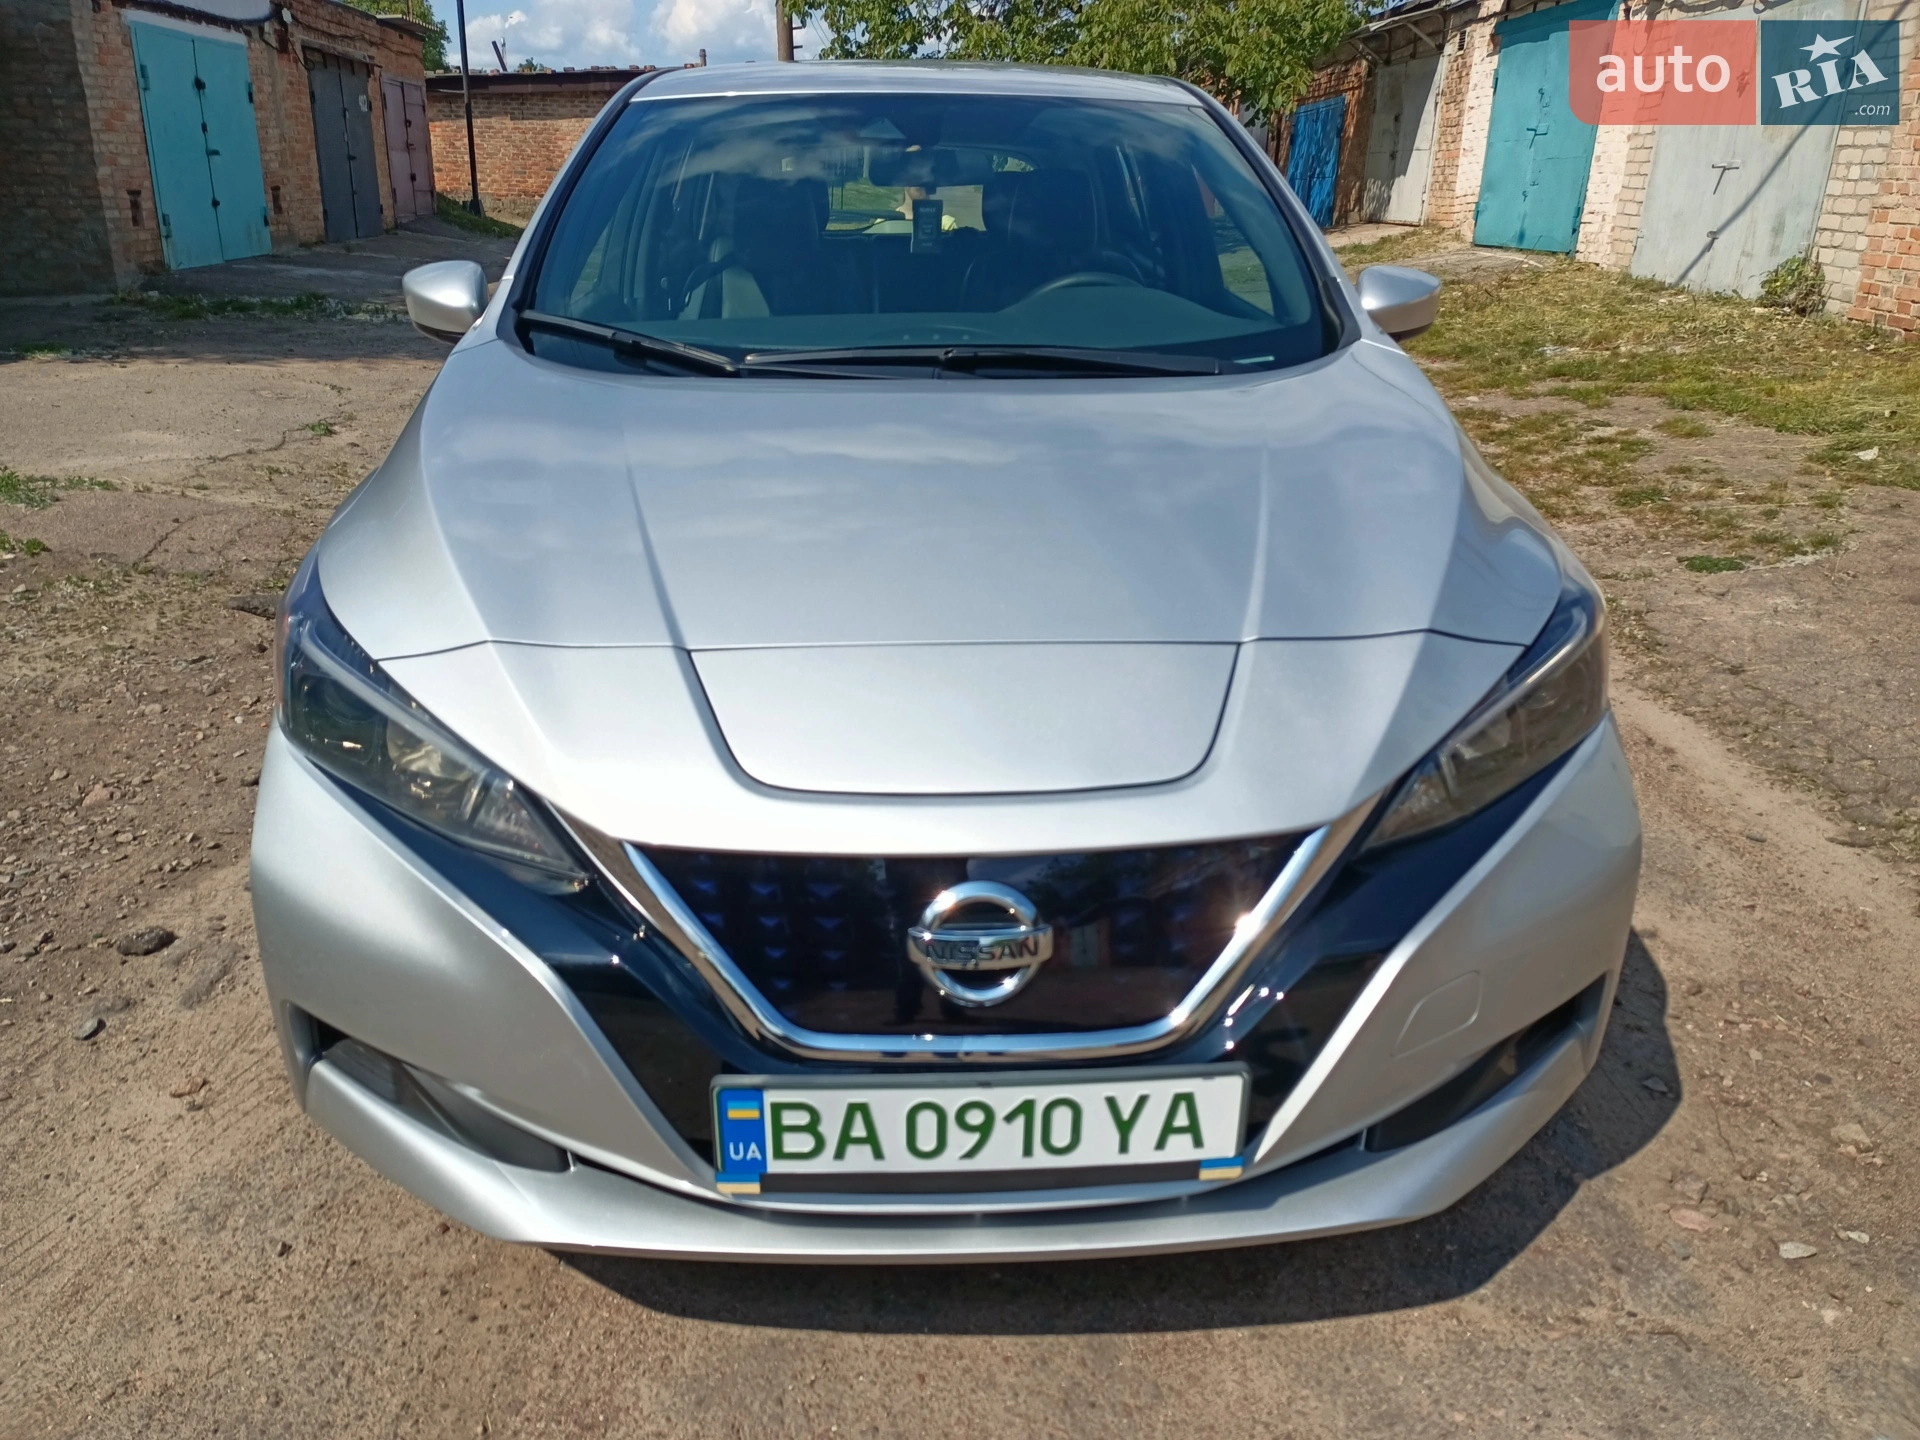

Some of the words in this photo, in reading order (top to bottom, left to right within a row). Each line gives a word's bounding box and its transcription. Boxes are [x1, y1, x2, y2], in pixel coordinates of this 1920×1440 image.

[926, 938, 1039, 963] NISSAN
[770, 1102, 886, 1161] BA
[905, 1097, 1083, 1160] 0910
[1103, 1091, 1205, 1155] YA
[729, 1141, 762, 1161] UA
